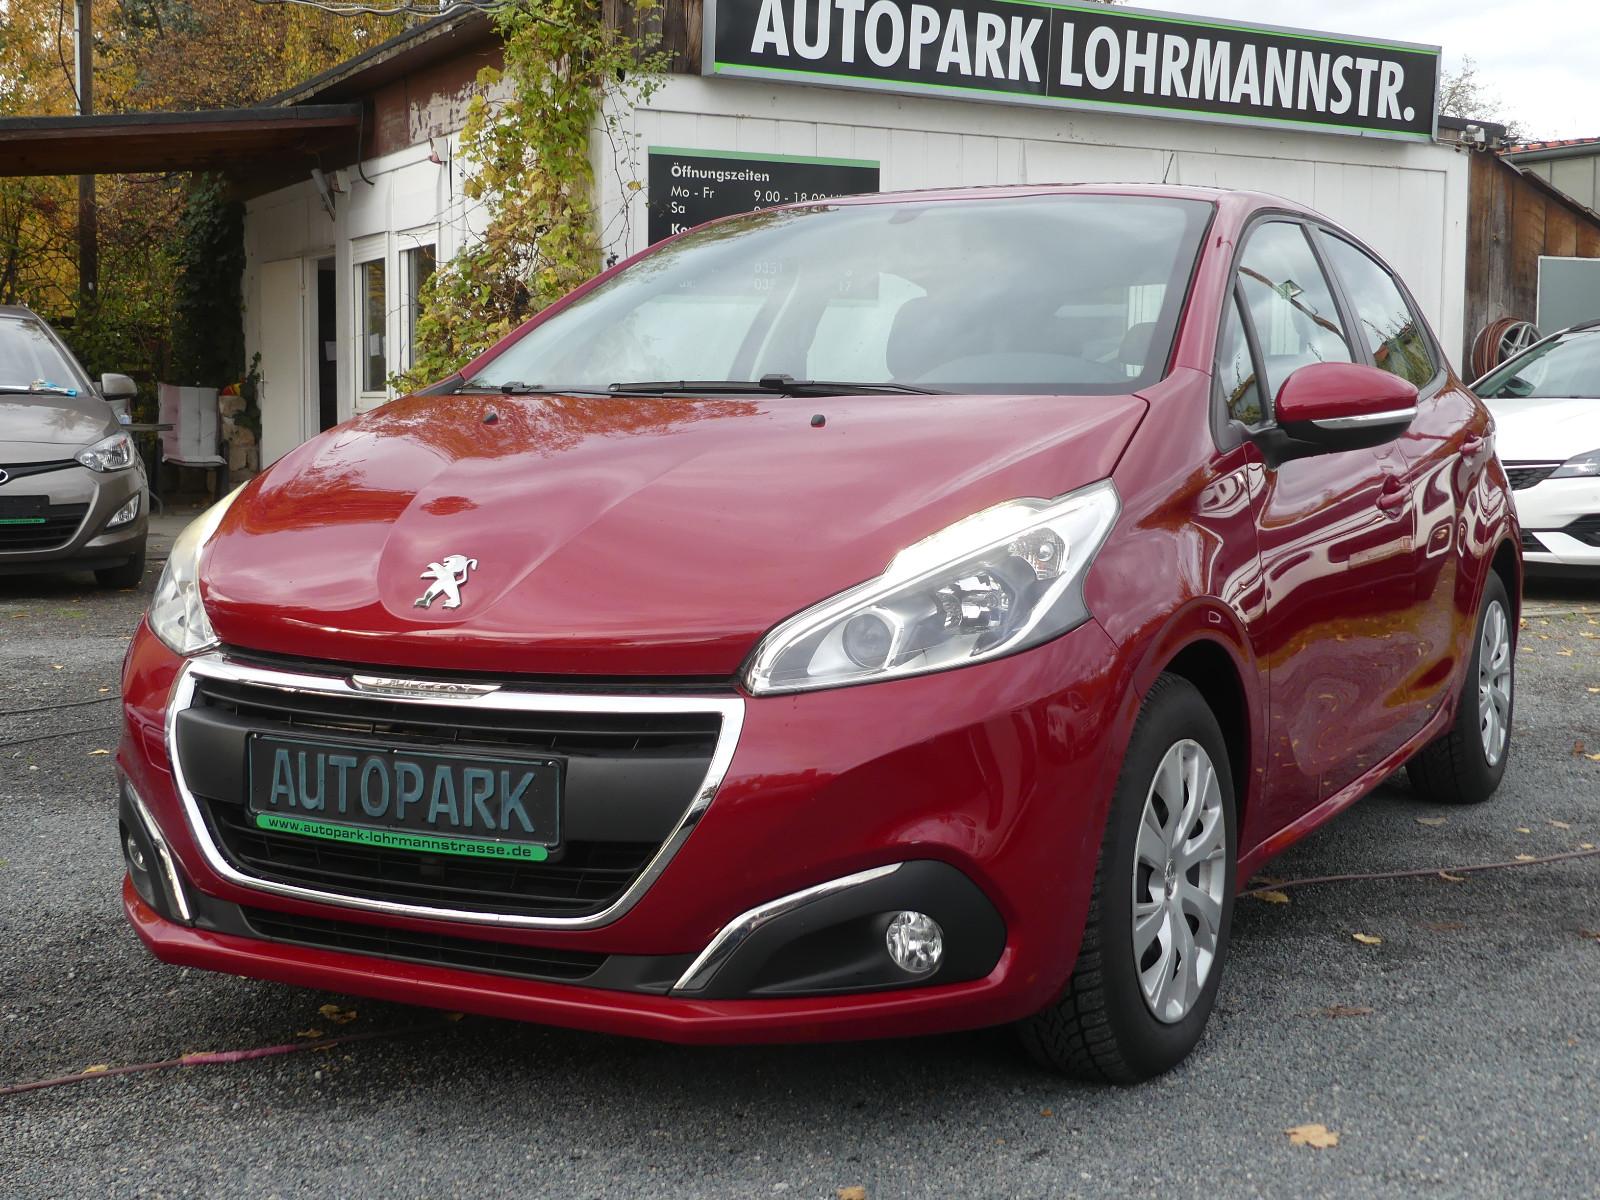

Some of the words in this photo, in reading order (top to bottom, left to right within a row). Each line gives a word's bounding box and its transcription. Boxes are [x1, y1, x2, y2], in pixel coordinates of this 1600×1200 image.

[750, 0, 1044, 83] AUTOPARK
[1059, 22, 1415, 122] LOHRMANNSTR.
[671, 162, 770, 182] Öffnungszeiten
[670, 185, 690, 198] Mo
[703, 186, 715, 199] Fr
[753, 189, 780, 203] 9.00
[671, 201, 686, 214] Sa
[270, 748, 536, 833] AUTOPARK
[268, 818, 532, 858] www.autopark-lohrmannstrasse.de
